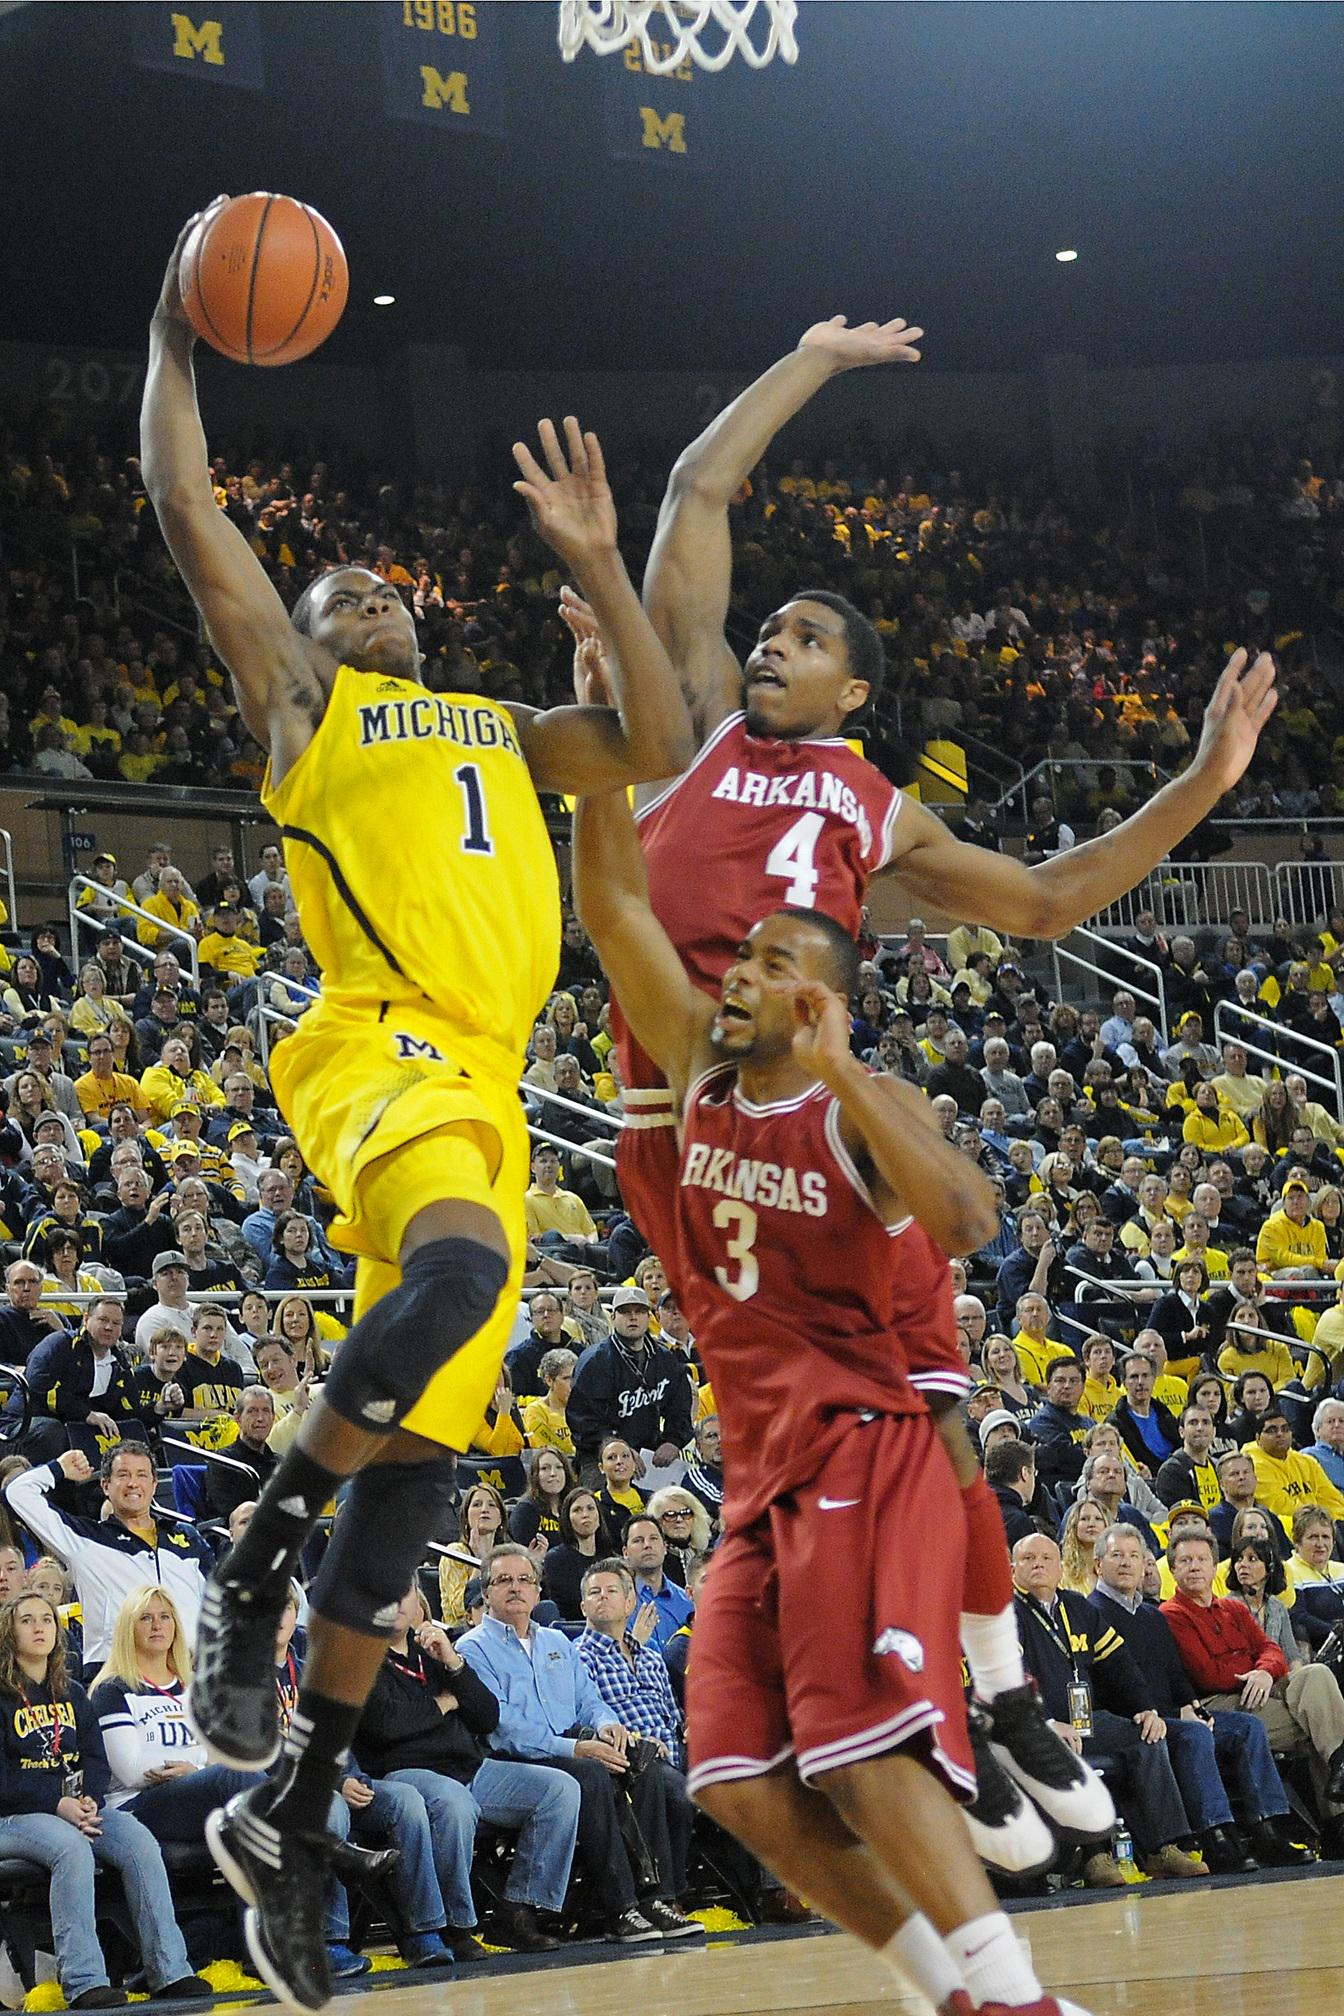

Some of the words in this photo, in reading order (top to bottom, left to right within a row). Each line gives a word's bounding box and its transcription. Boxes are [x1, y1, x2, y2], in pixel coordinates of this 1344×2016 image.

[171, 13, 224, 65] M
[403, 0, 478, 39] 1986
[420, 65, 470, 114] M
[640, 107, 687, 153] M
[454, 763, 496, 855] 1
[70, 837, 91, 849] 106
[765, 811, 826, 908] 4
[394, 1034, 444, 1062] M
[712, 1199, 759, 1302] 3
[476, 1469, 506, 1490] M
[1069, 1633, 1089, 1653] M
[14, 1701, 77, 1739] CHELSEA
[139, 1704, 184, 1726] MICHI
